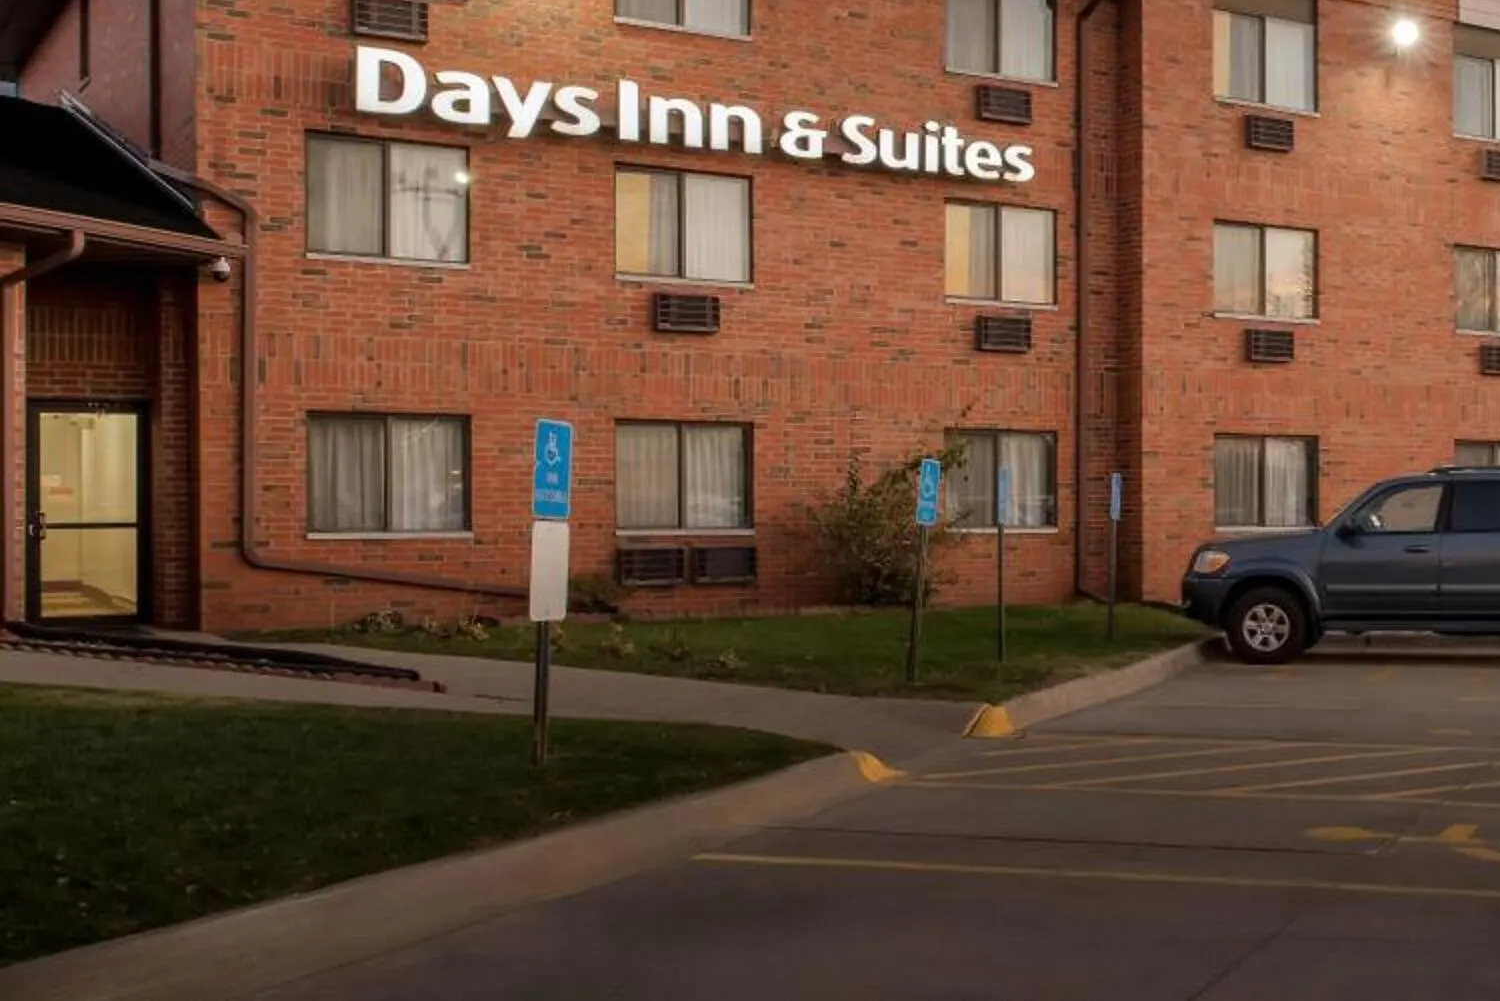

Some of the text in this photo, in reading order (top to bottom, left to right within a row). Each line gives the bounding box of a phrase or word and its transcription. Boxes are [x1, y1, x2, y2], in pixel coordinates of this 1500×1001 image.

[356, 45, 1036, 183] Days Inn & Suites
